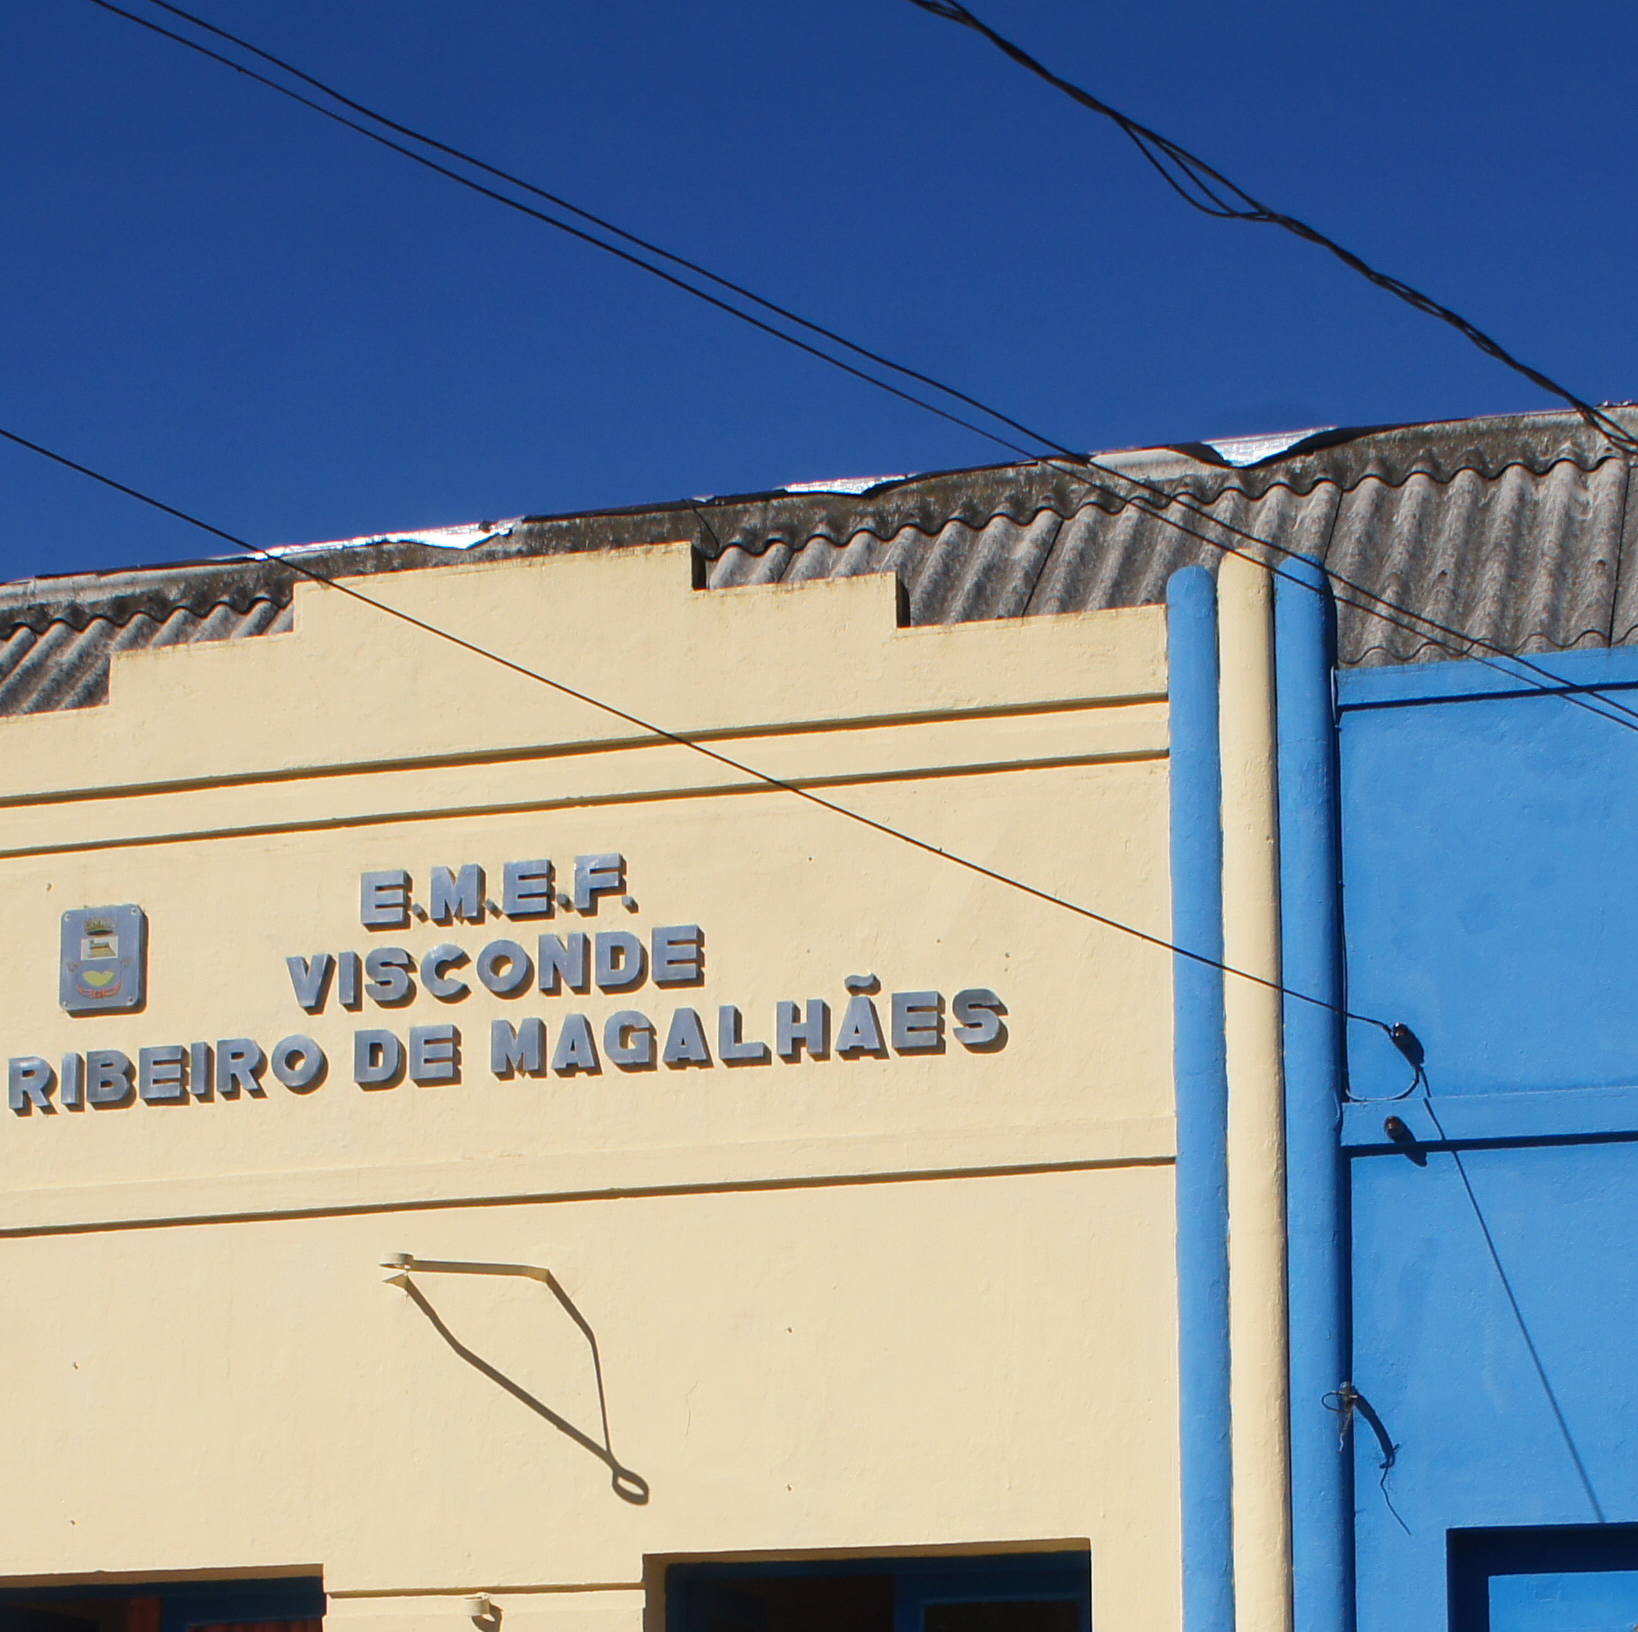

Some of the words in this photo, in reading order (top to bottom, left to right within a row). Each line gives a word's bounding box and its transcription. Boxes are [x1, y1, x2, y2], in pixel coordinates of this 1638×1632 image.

[360, 853, 638, 931] E.M.E.F.
[286, 924, 705, 1014] VISCONDE
[8, 1033, 328, 1117] RIBEIRO
[354, 1023, 462, 1090] DE
[491, 971, 1008, 1081] MAGALHÃES
